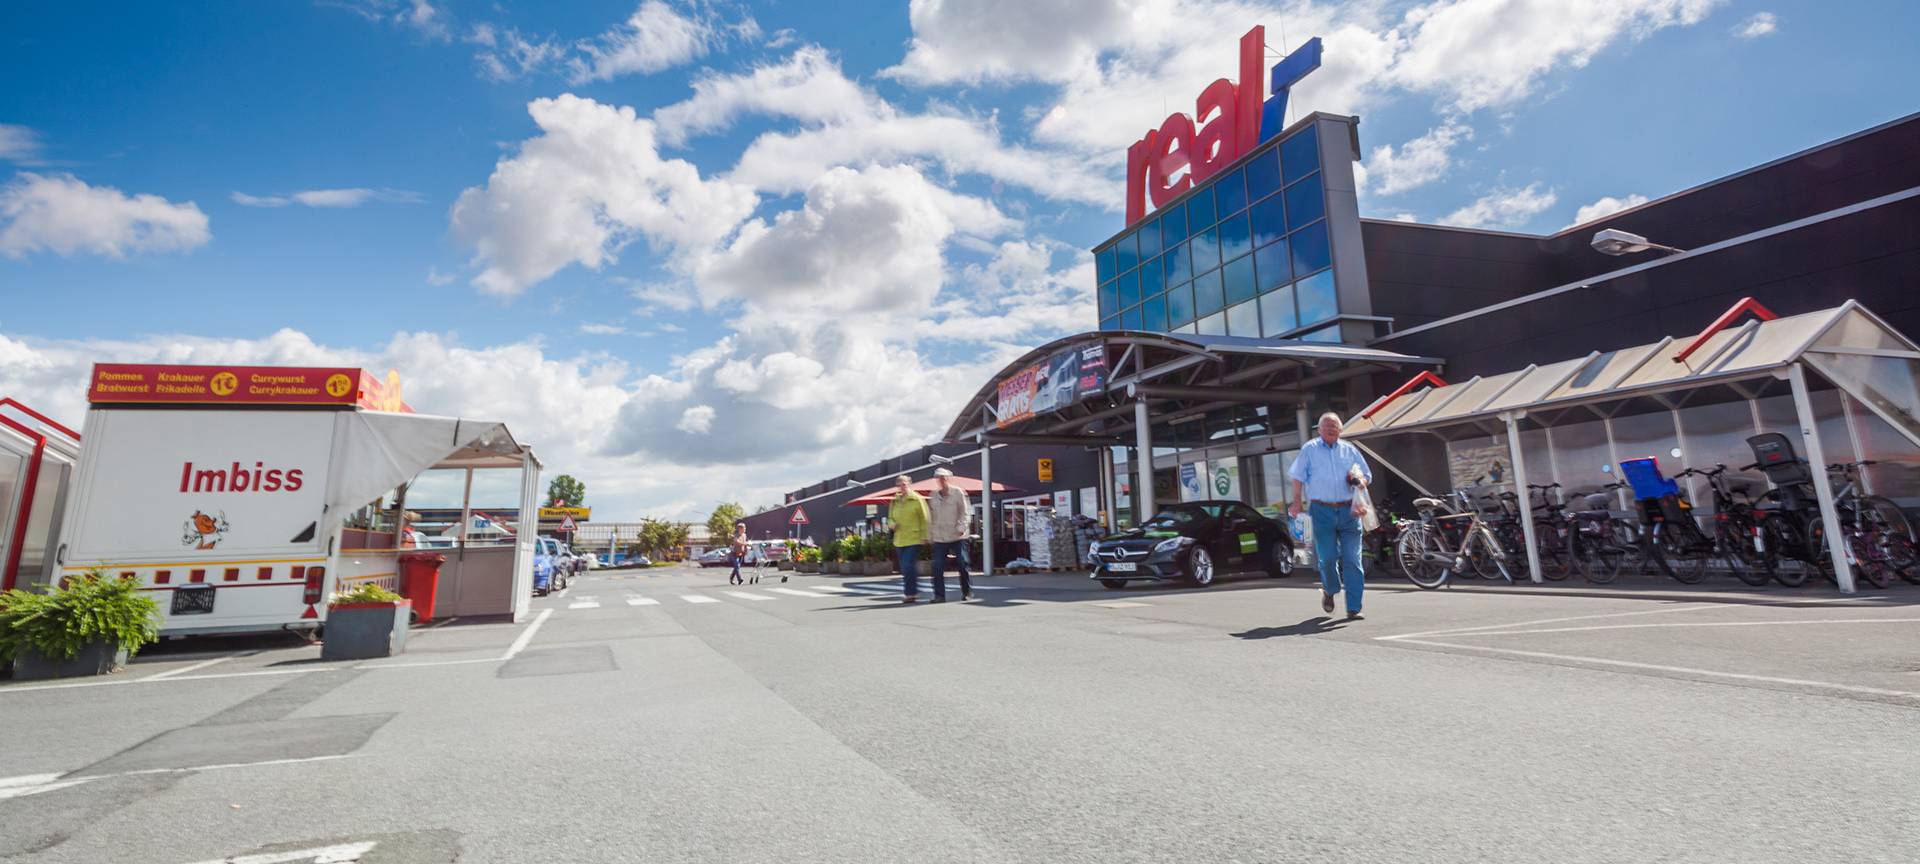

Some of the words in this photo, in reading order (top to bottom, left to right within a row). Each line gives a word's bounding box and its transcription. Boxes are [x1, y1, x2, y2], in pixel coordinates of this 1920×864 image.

[99, 371, 144, 381] Pommes
[158, 371, 205, 382] Krakauer
[251, 374, 306, 384] Currywurst
[96, 383, 149, 393] Bratwurst
[156, 383, 206, 394] Frikadelle
[249, 385, 320, 396] Currykrakauer
[179, 461, 304, 492] Imbiss
